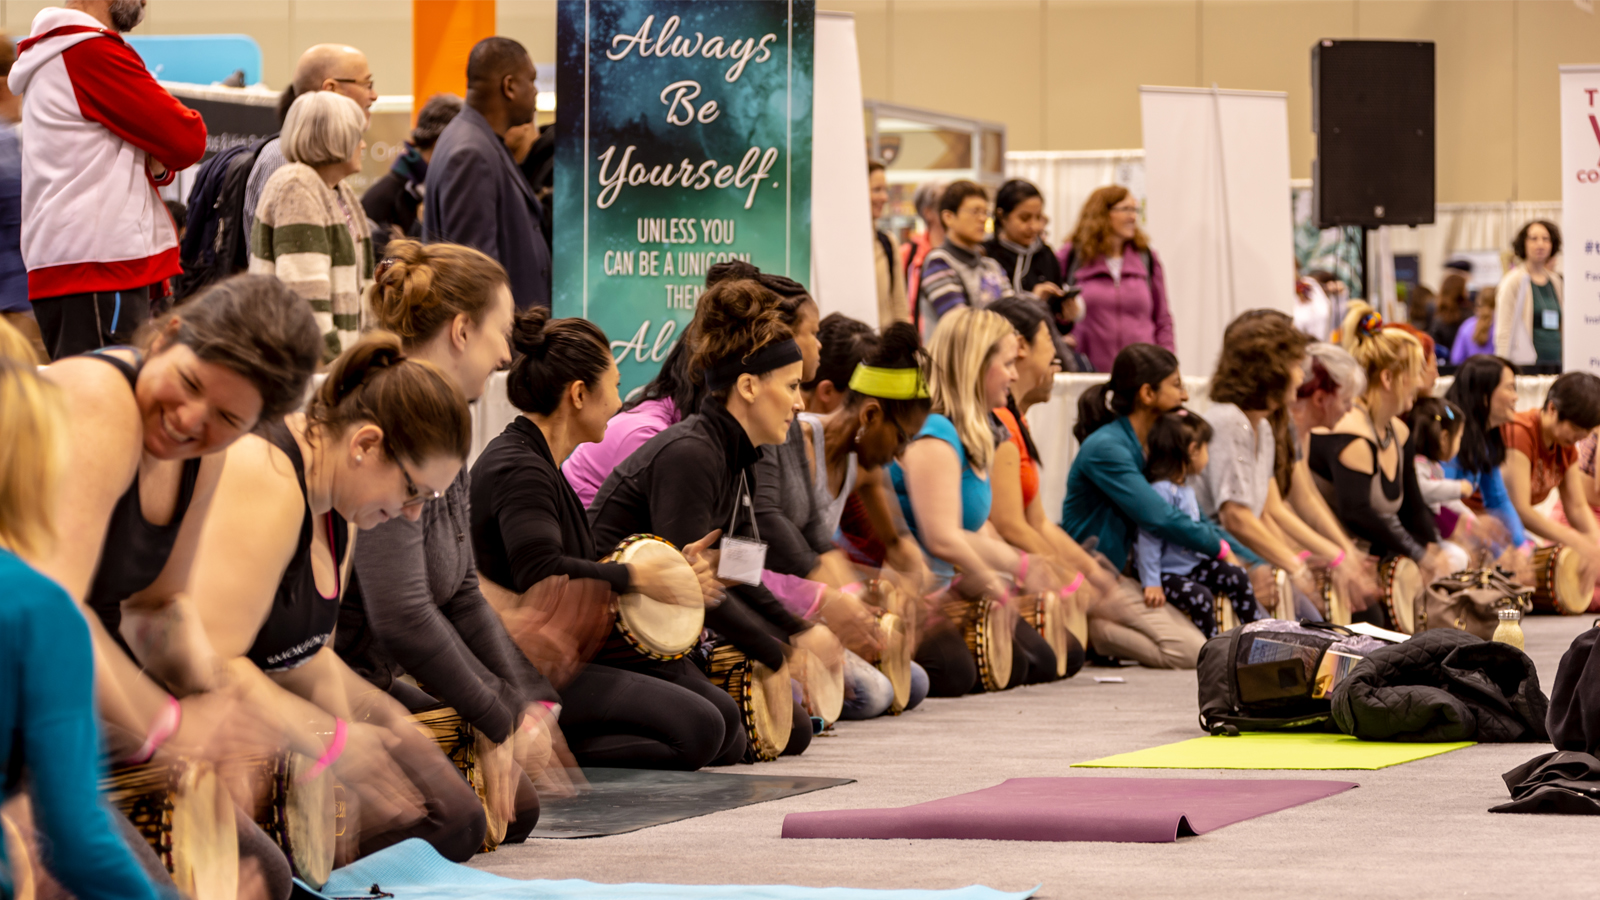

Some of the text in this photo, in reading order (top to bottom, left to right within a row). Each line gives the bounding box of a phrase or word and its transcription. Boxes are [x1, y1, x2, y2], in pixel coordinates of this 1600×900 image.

[606, 15, 777, 83] Always
[660, 80, 721, 126] Be
[597, 145, 779, 209] Yourself.
[637, 217, 735, 244] UNLESS YOU
[604, 250, 634, 276] CAN
[639, 251, 660, 276] BE
[663, 251, 675, 276] A
